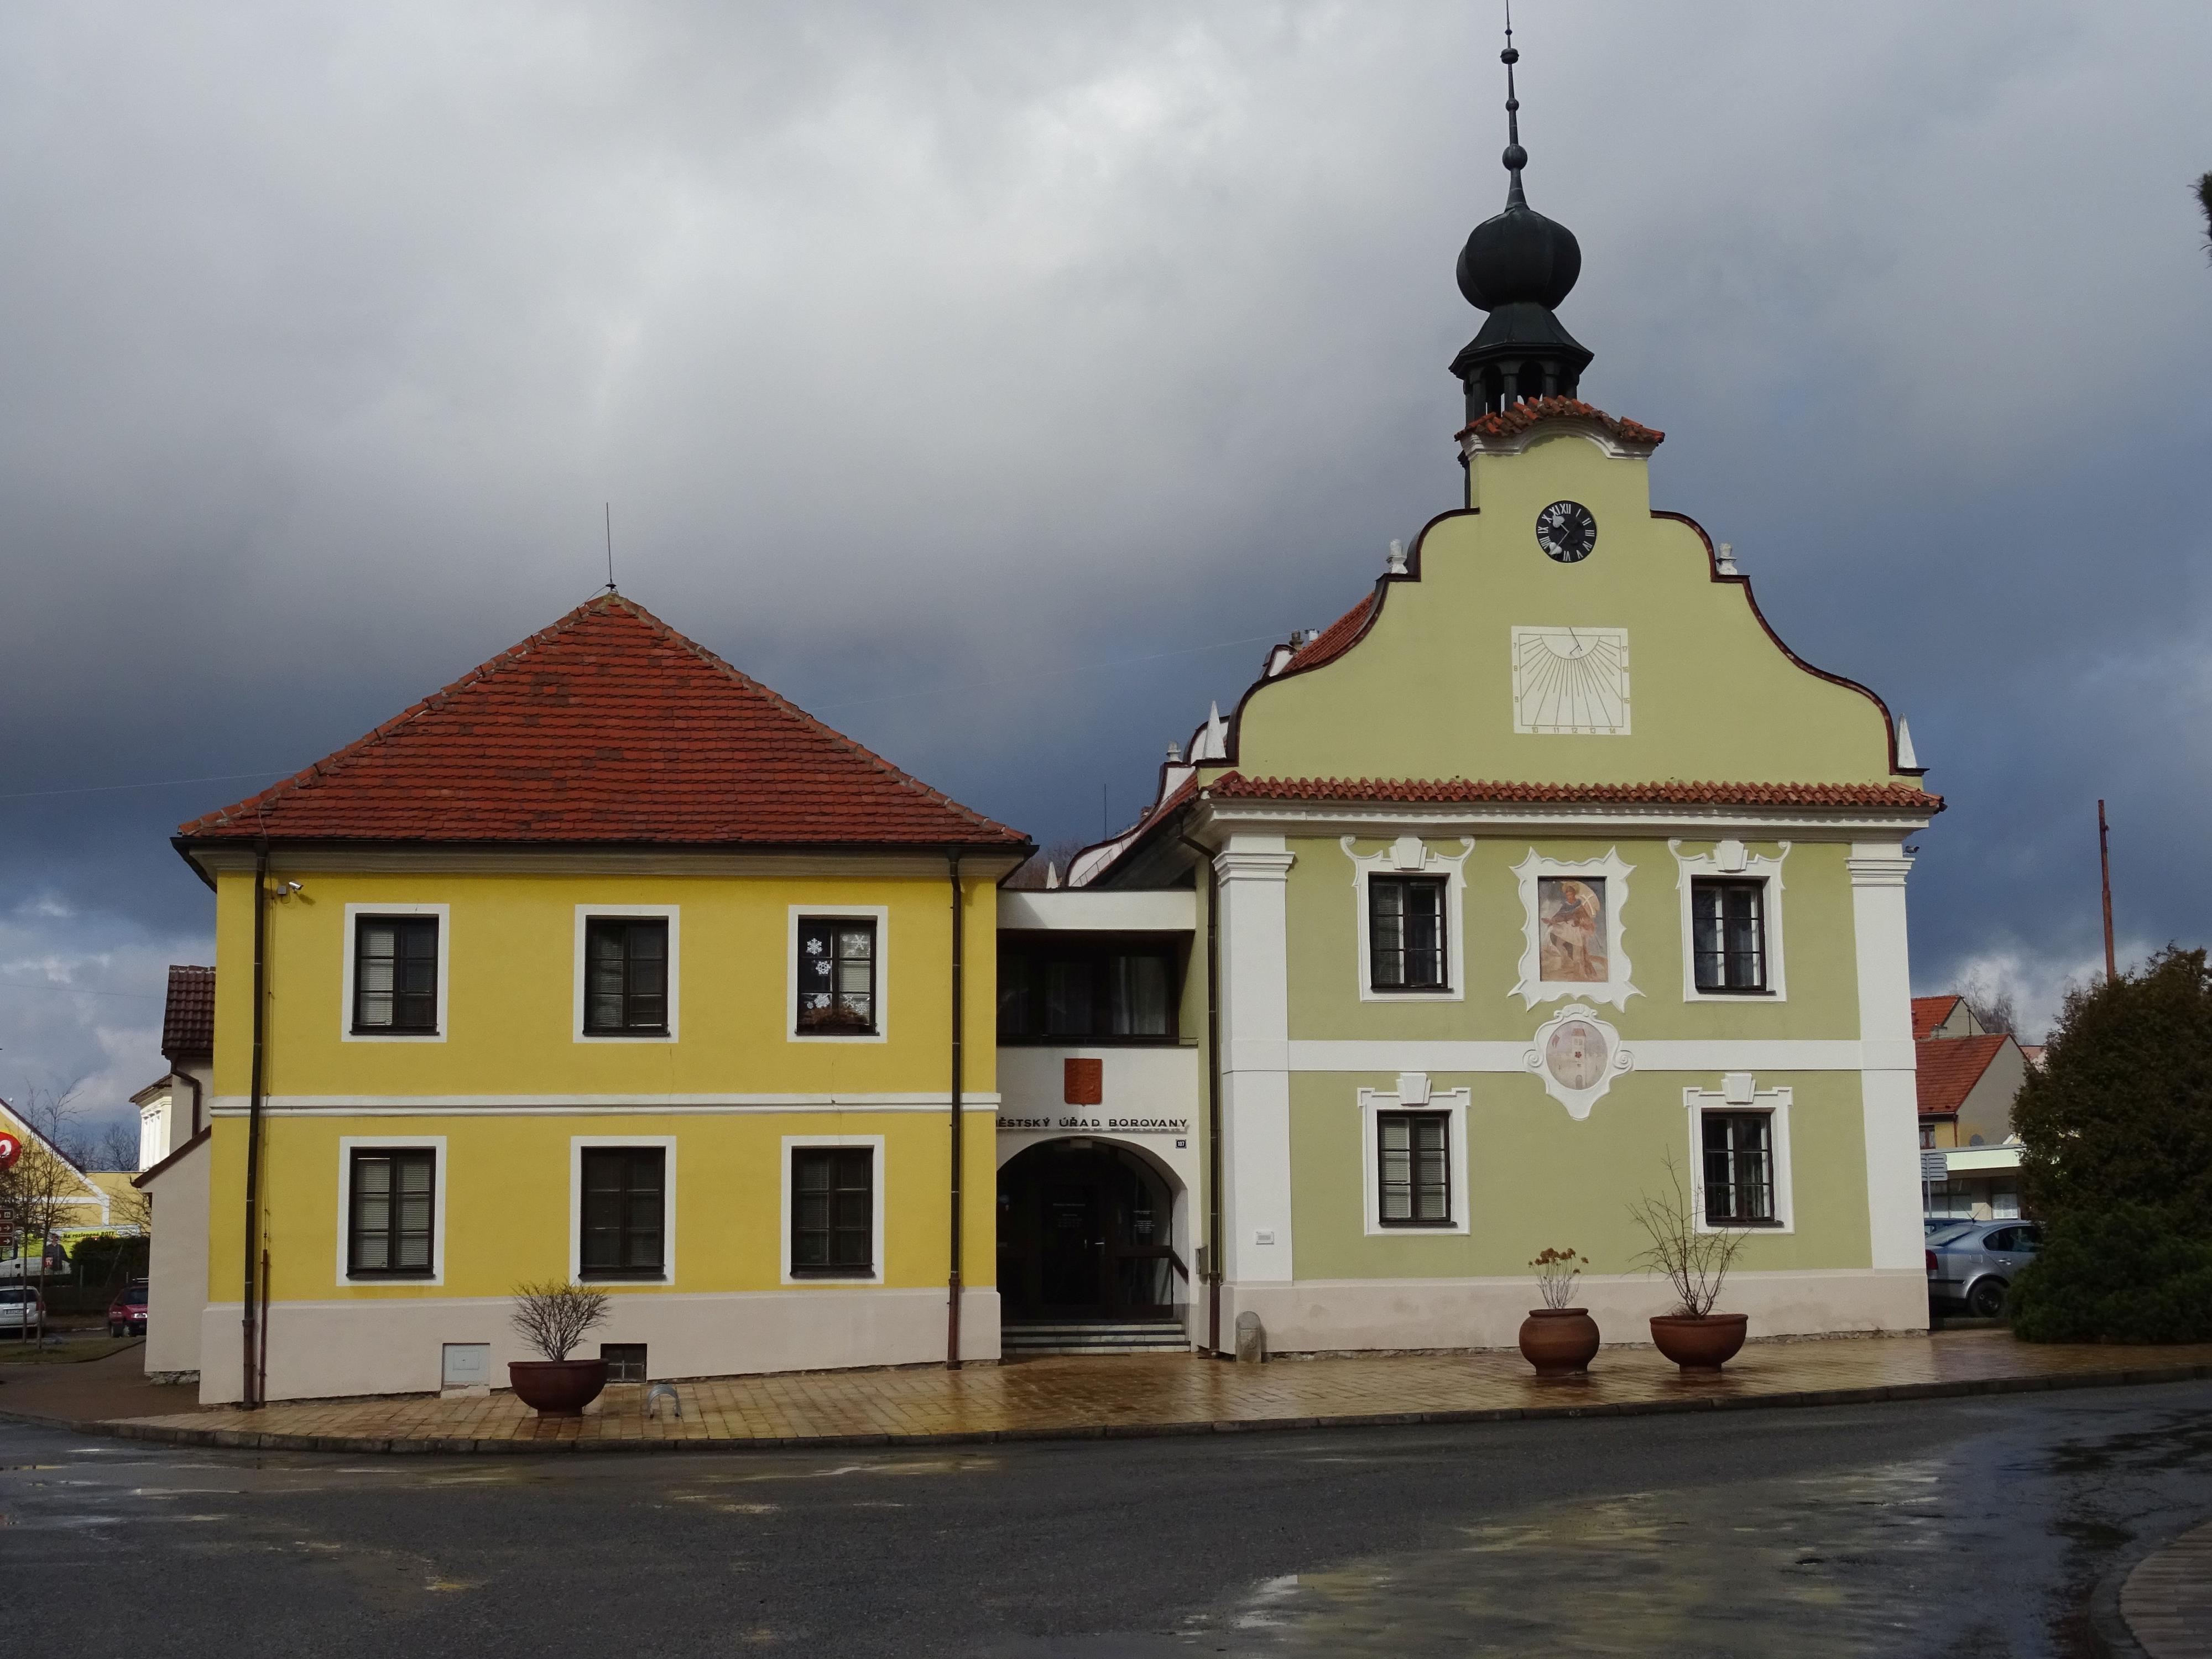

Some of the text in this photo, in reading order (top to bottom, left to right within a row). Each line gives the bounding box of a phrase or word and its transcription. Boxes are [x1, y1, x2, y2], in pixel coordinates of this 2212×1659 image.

[1559, 503, 1571, 514] XII
[1541, 514, 1553, 523] X
[1582, 518, 1592, 526] II
[996, 1117, 1187, 1128] ĚSTSKÝ ÚŘAD BOROVANY
